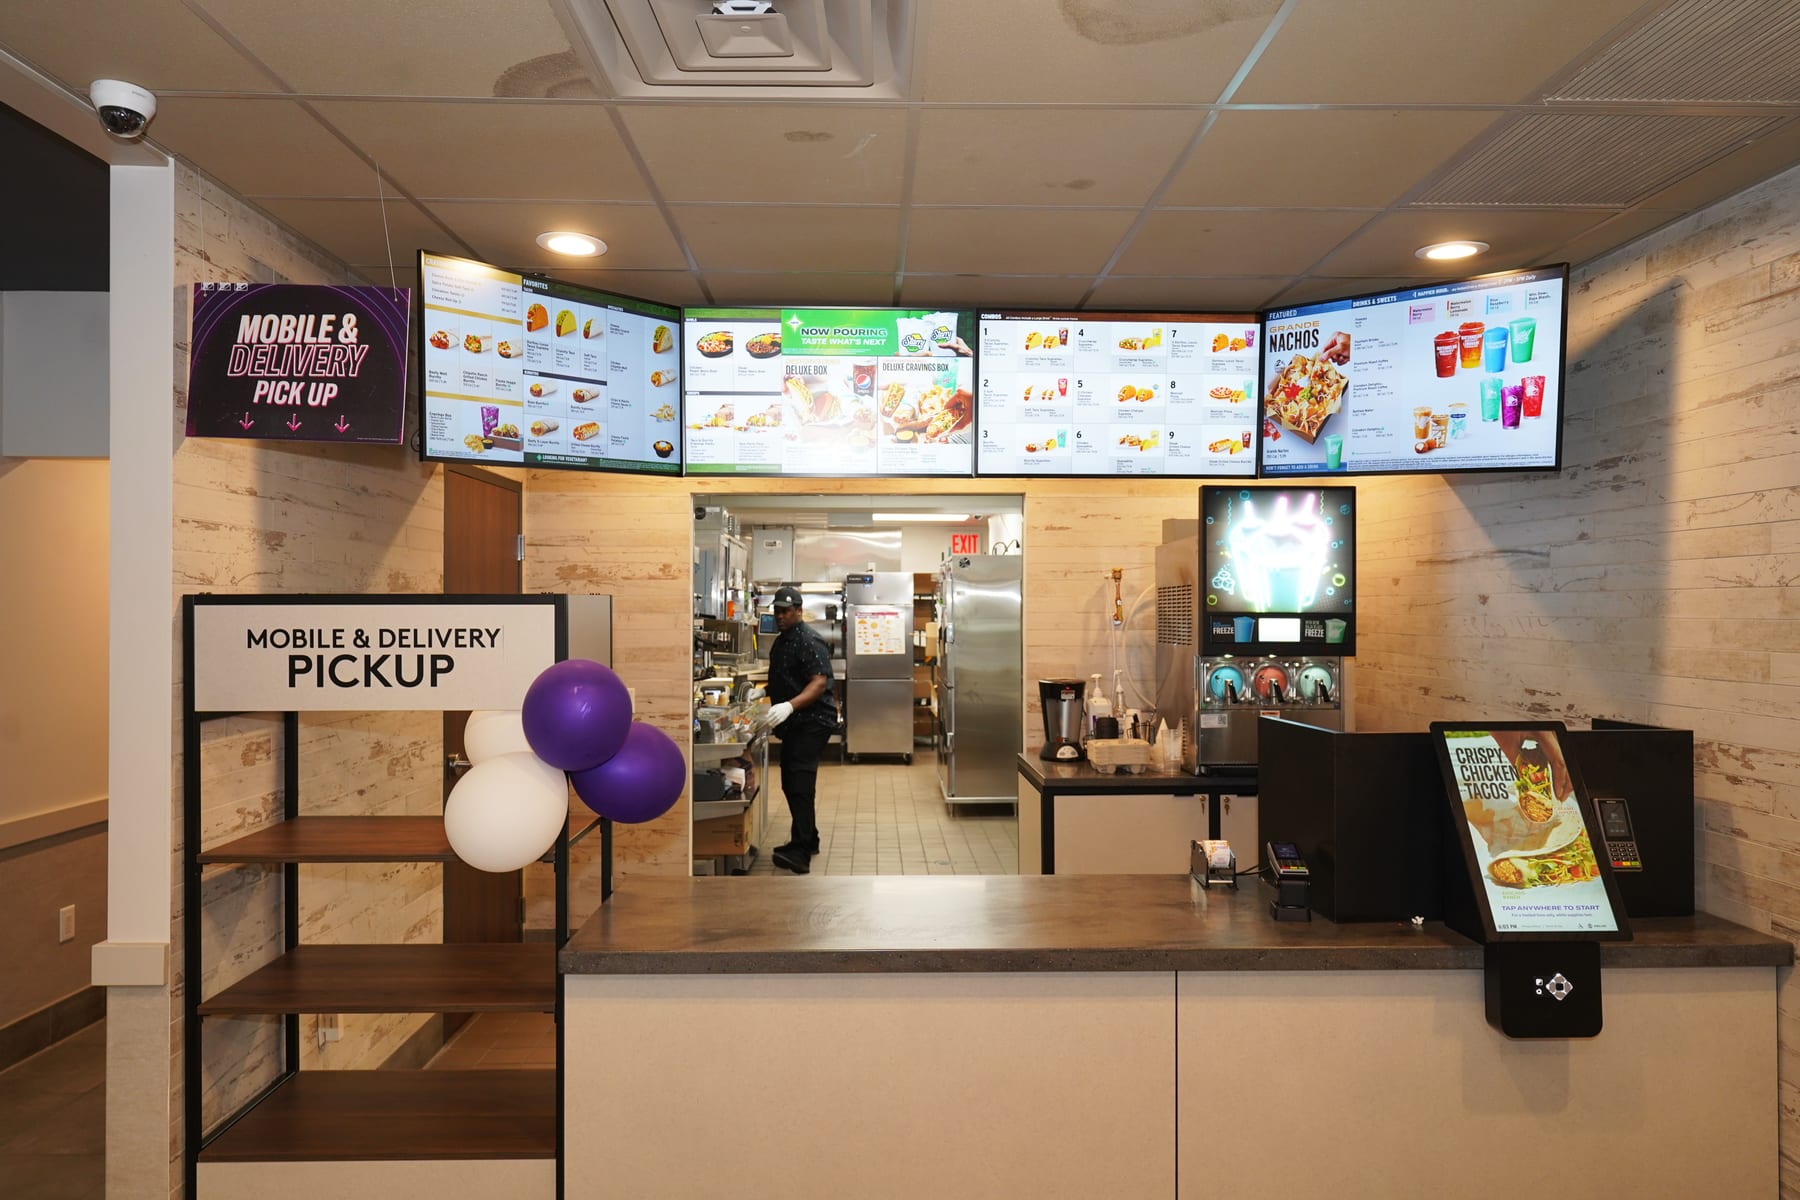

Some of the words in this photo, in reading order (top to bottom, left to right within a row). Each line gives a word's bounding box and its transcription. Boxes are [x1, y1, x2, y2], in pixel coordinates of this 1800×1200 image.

[523, 279, 548, 290] FAVORITES
[1269, 310, 1297, 320] FEATURED
[236, 314, 336, 344] MOBILE
[338, 313, 358, 344] &
[834, 328, 888, 336] POURING
[984, 328, 988, 336] 1
[1172, 330, 1177, 338] 7
[1270, 321, 1320, 333] GRANDE
[1270, 328, 1319, 353] NACHOS
[227, 344, 369, 377] DELIVERY
[882, 363, 904, 371] DELUXE
[906, 363, 936, 372] CRAVINGS
[937, 363, 949, 371] BOX
[786, 365, 812, 376] DELUXE
[814, 365, 828, 375] BOX
[253, 380, 305, 405] PICK
[307, 382, 339, 406] UP
[952, 534, 979, 554] EXIT
[1213, 626, 1234, 634] FREEZE
[1304, 629, 1324, 637] FREEZE
[247, 629, 345, 648] MOBILE
[352, 628, 370, 648] &
[379, 628, 501, 648] DELIVERY
[288, 654, 455, 688] PICKUP
[1456, 747, 1503, 764] CRISPY
[1460, 765, 1520, 781] CHICKEN
[1464, 782, 1509, 799] TACOS
